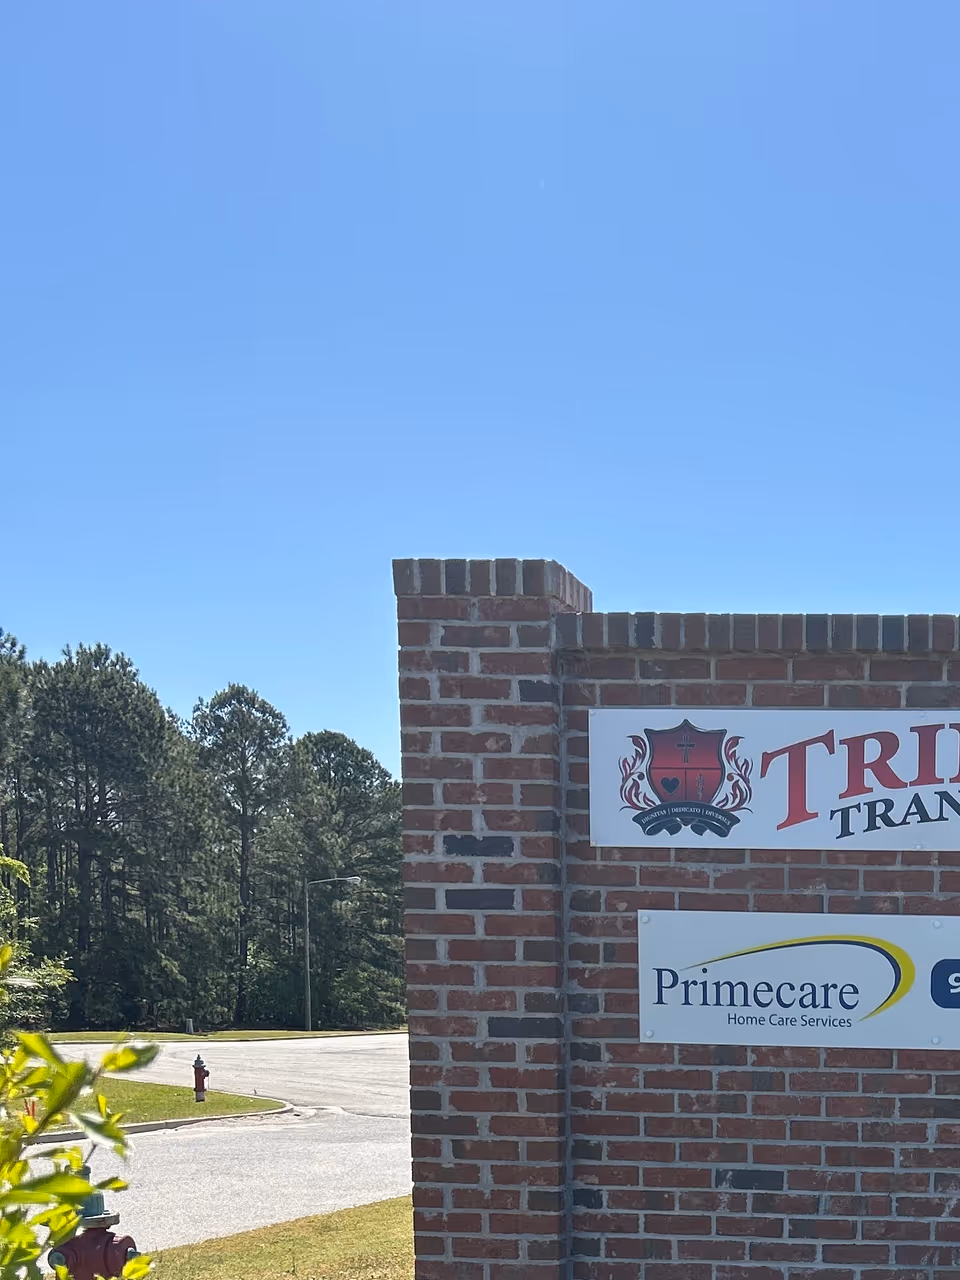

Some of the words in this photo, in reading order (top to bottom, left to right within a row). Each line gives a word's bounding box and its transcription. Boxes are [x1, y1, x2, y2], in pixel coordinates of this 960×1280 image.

[671, 806, 701, 814] DEDICATO
[652, 966, 861, 1011] Primecare
[727, 1012, 766, 1027] Home
[768, 1013, 798, 1027] Care
[800, 1013, 853, 1029] Services
